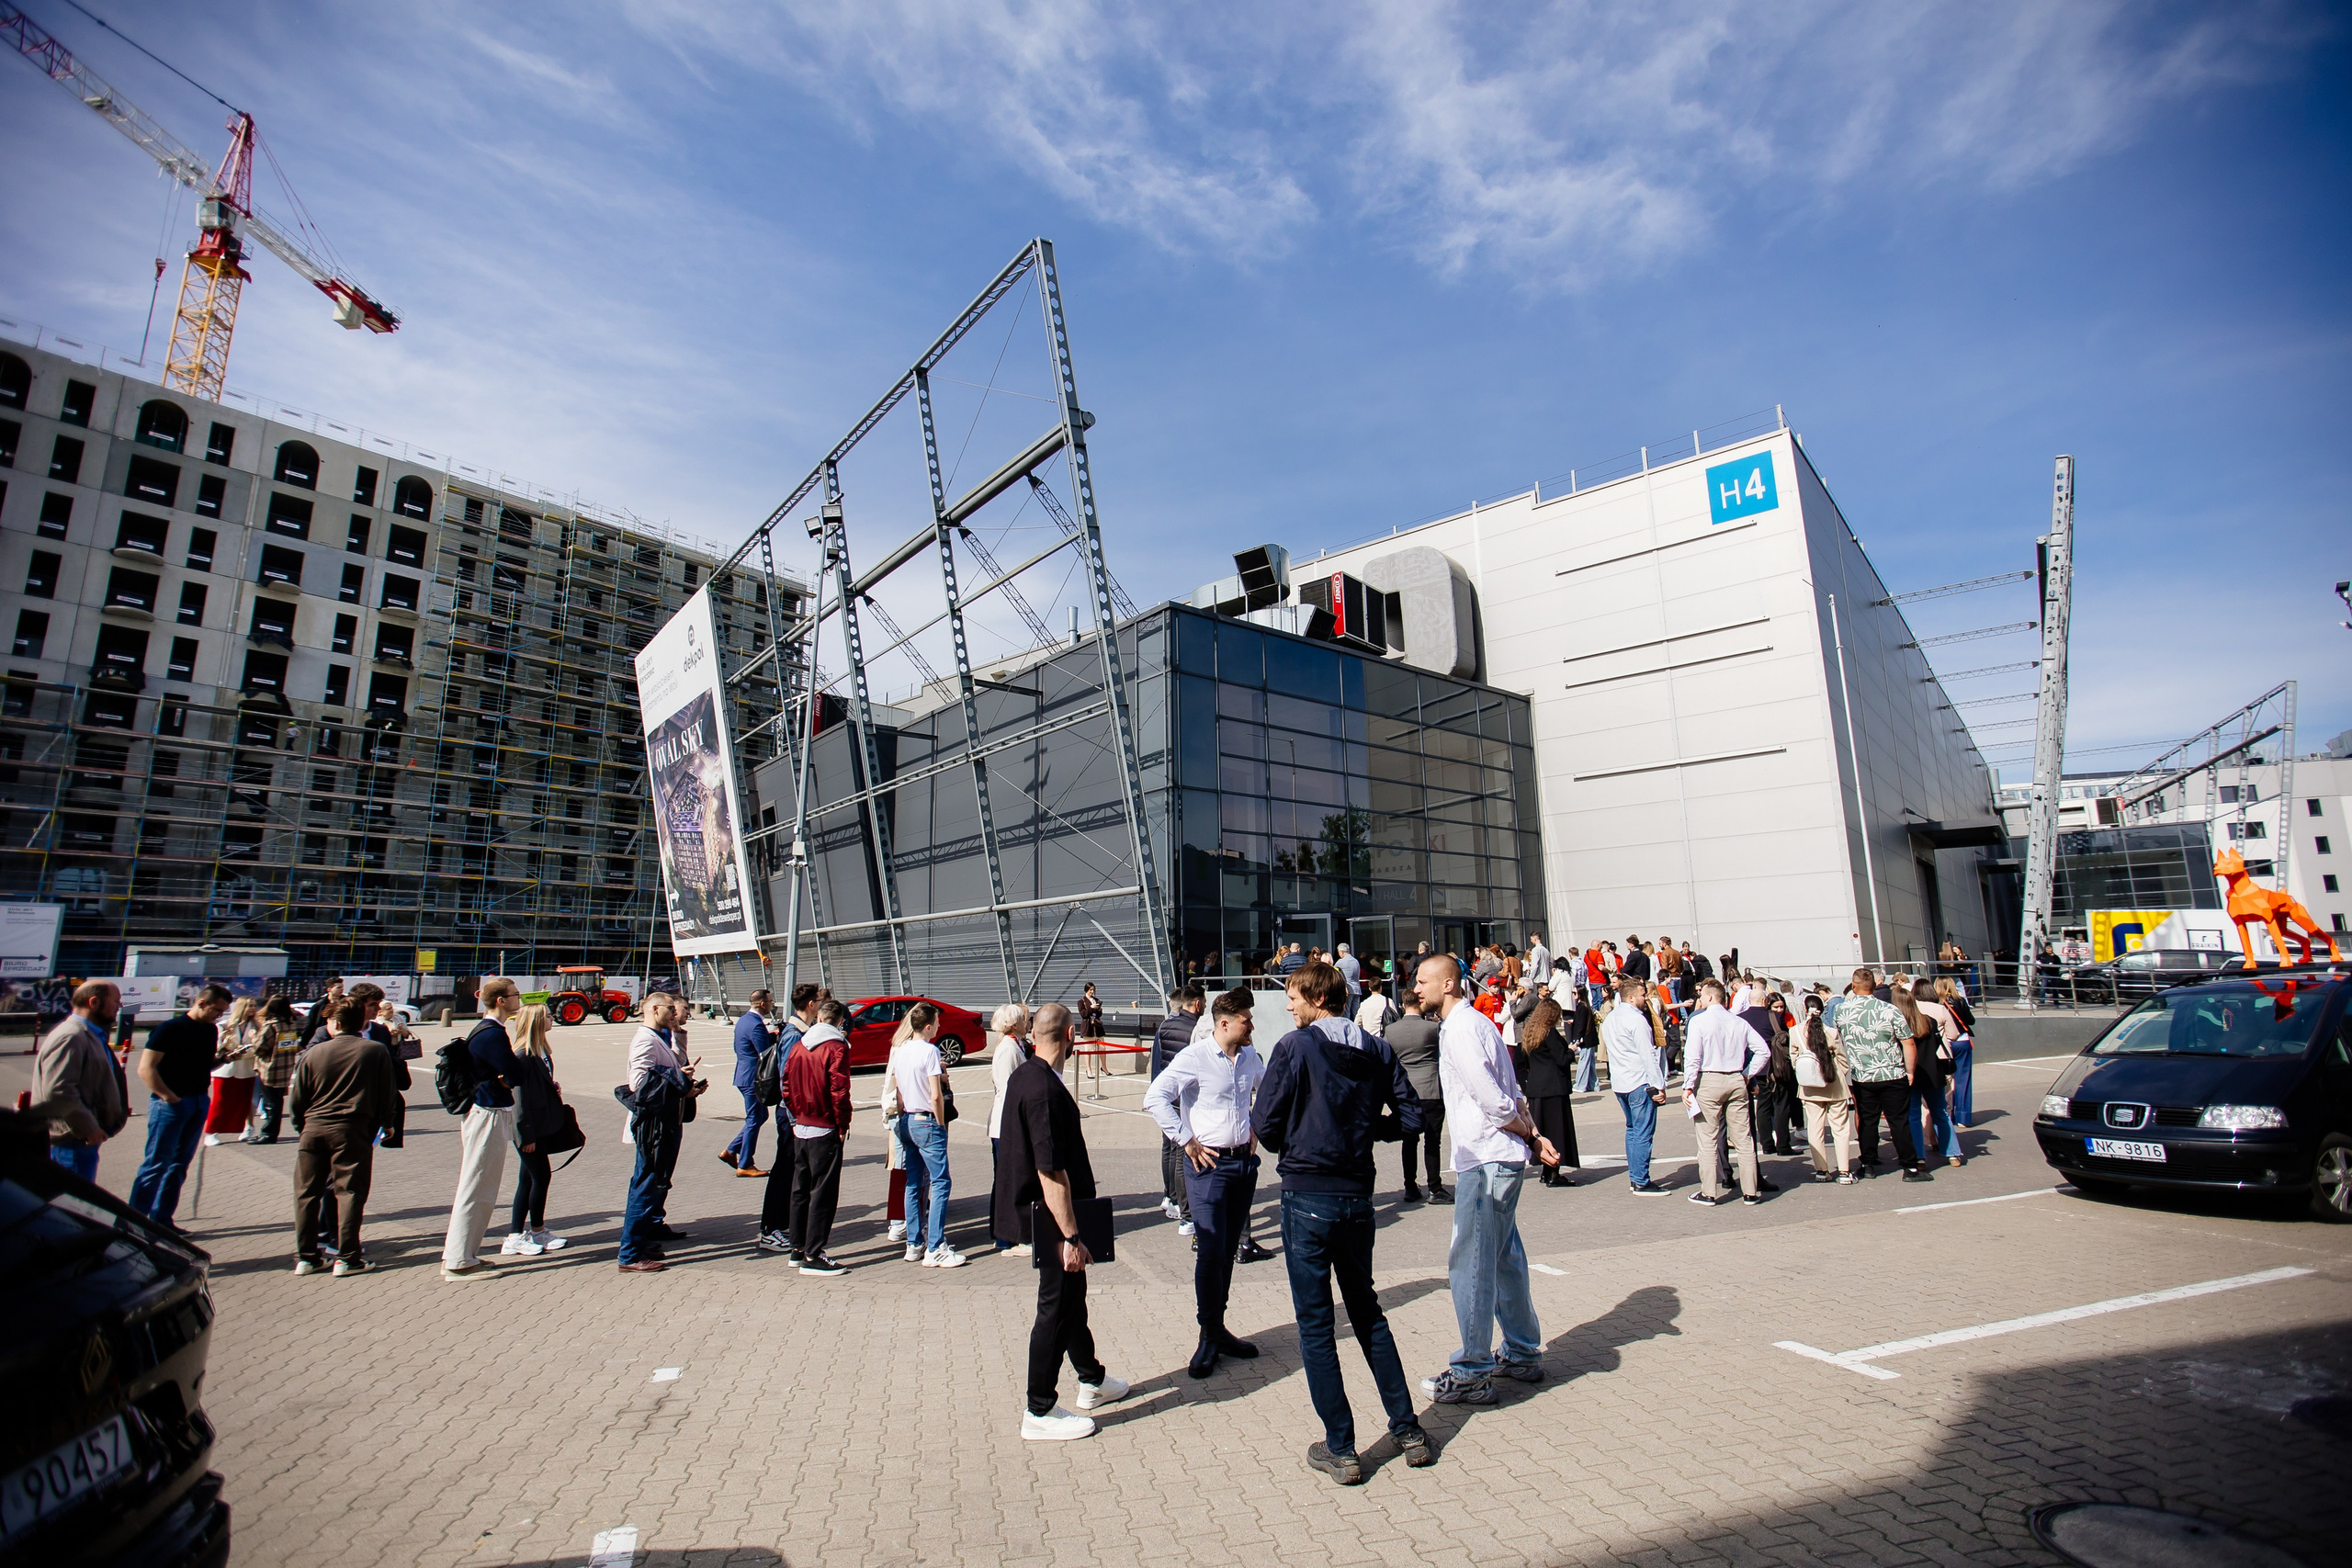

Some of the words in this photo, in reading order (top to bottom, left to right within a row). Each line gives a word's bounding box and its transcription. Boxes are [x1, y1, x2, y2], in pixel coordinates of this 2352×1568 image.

[1720, 468, 1766, 509] H4
[683, 642, 705, 672] dekpol
[655, 737, 683, 773] OVAL
[681, 718, 705, 756] SKY
[1384, 890, 1406, 902] HALL
[1409, 886, 1418, 902] 4
[2095, 1140, 2162, 1157] NK-9816
[23, 1420, 121, 1515] 90457
